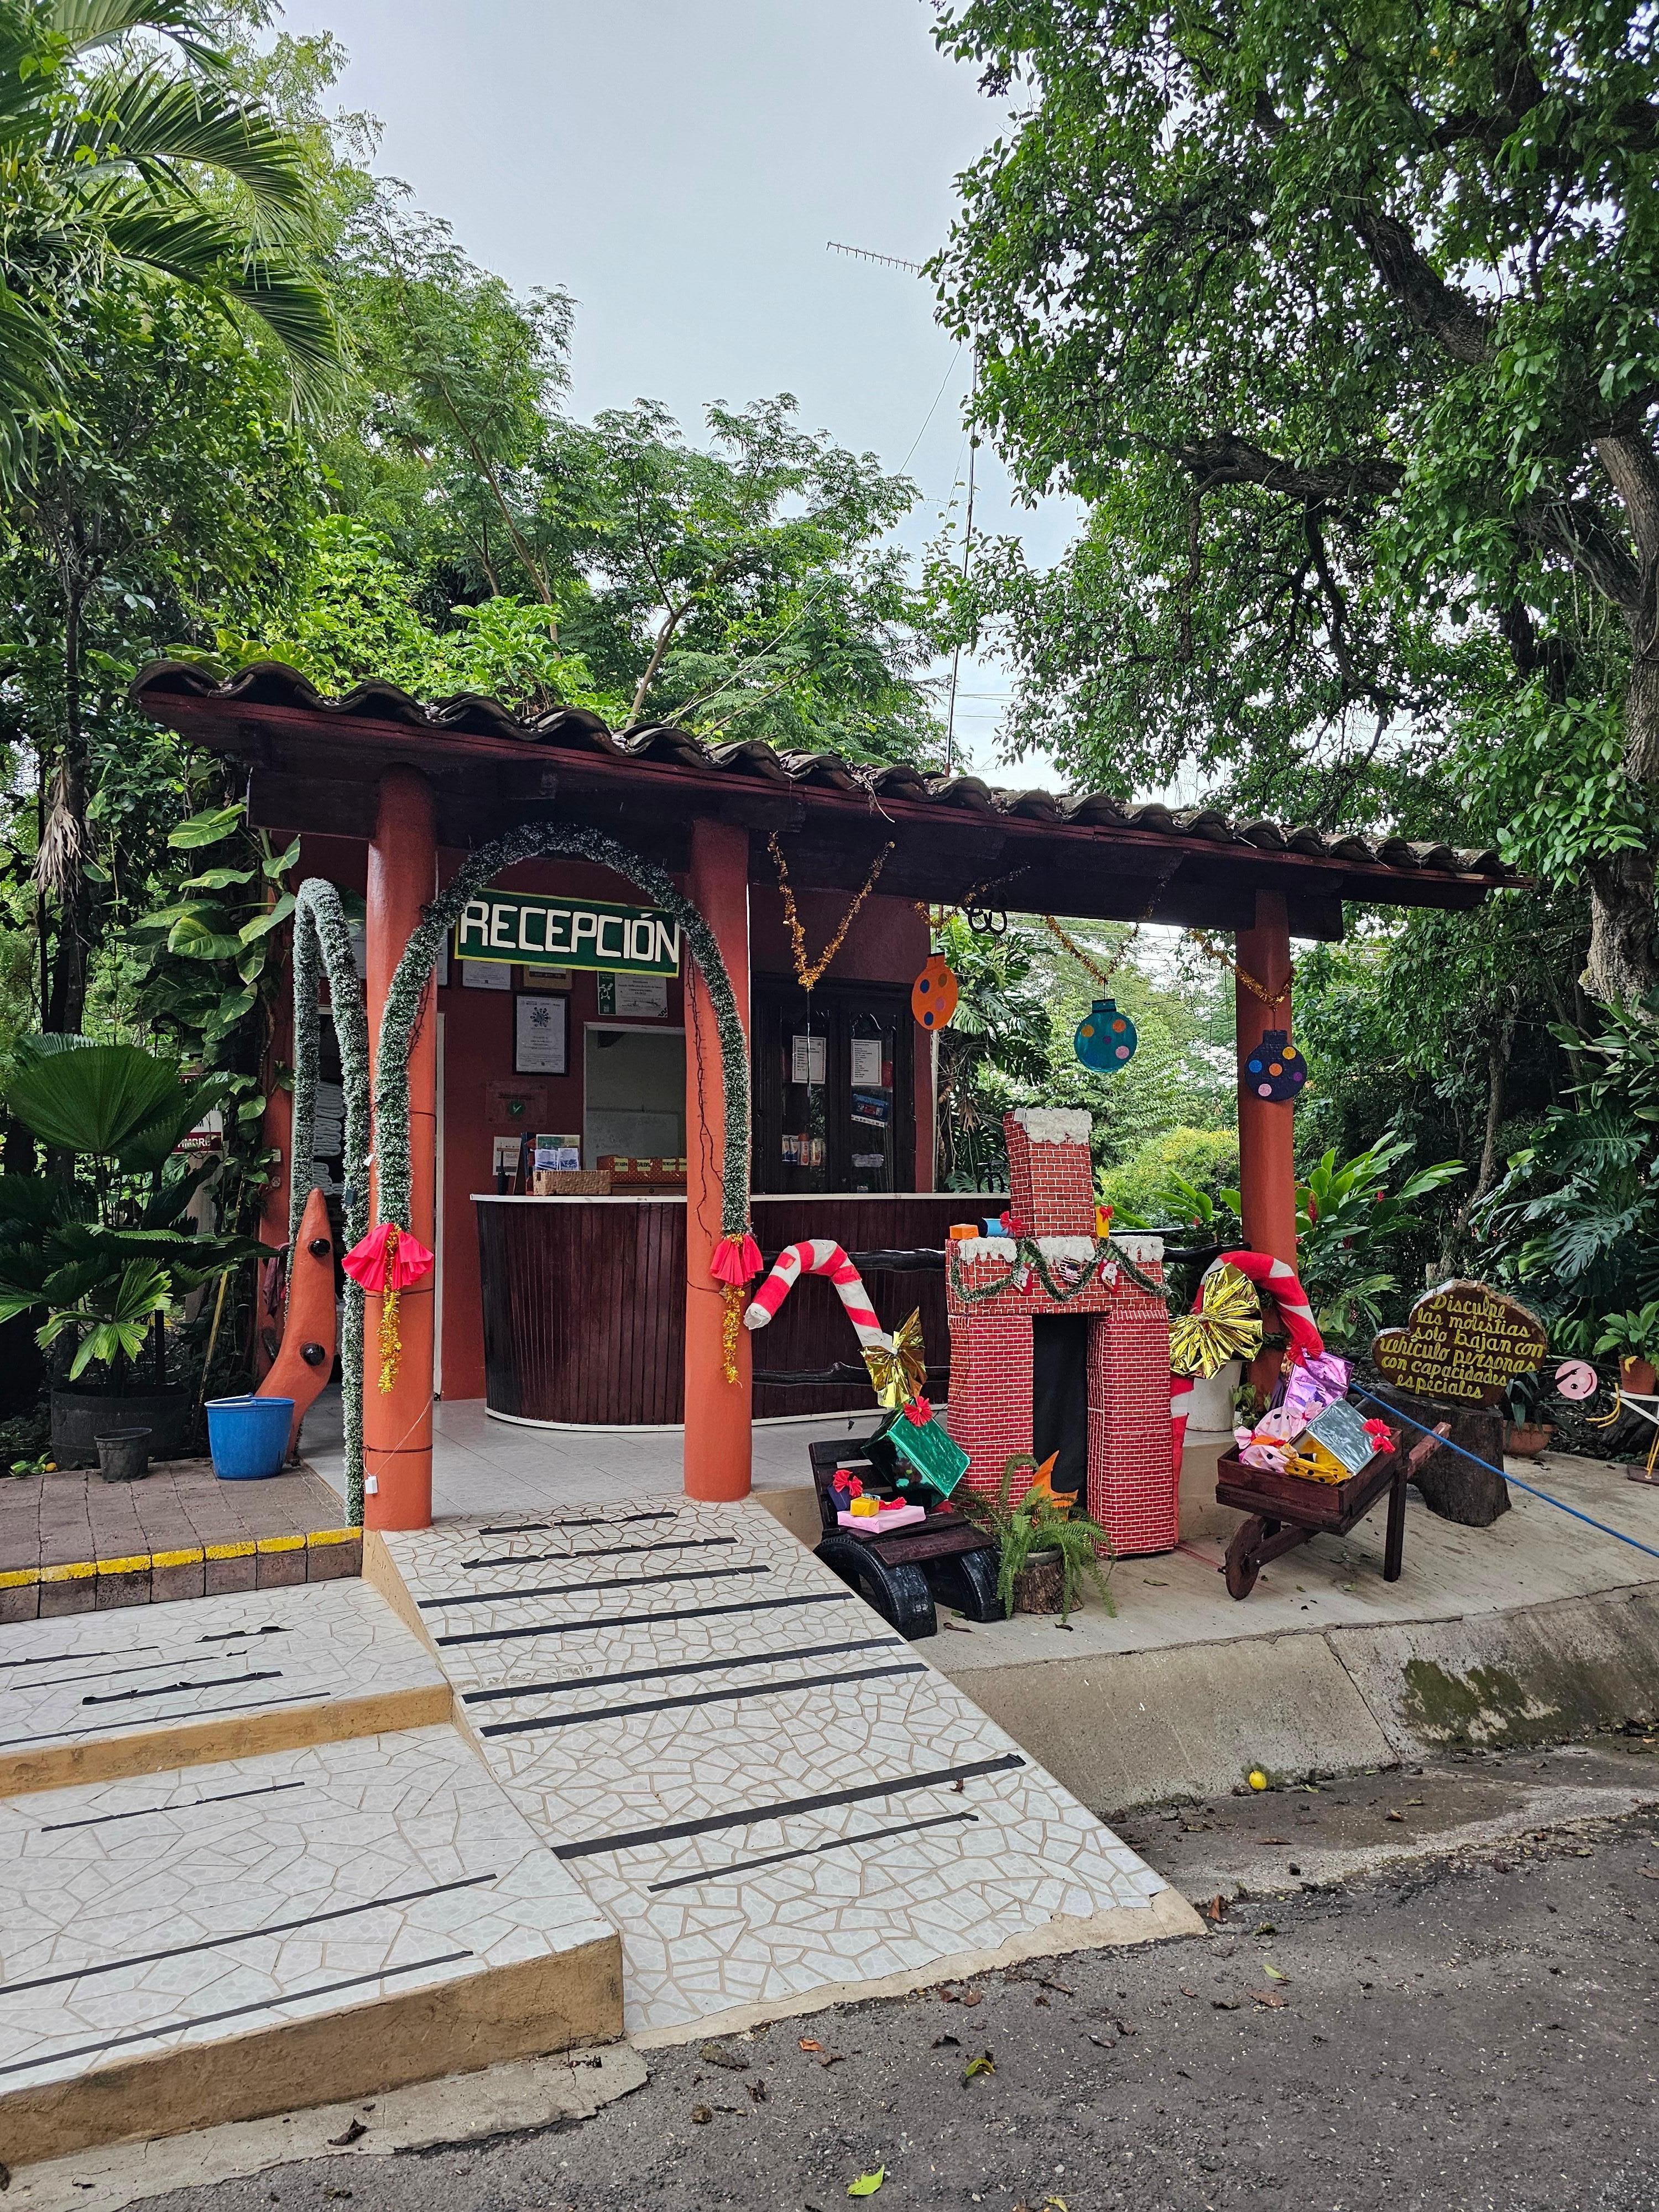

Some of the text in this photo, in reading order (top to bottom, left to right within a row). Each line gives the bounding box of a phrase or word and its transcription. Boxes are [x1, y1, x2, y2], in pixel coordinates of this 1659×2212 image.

[460, 901, 679, 963] RECEPCIÓN
[1416, 1307, 1531, 1338] las molestias
[1429, 1295, 1505, 1320] Disculpe
[1411, 1327, 1544, 1359] solo bajan con
[1381, 1356, 1507, 1386] con capacidades
[1453, 1350, 1536, 1373] personas
[1395, 1374, 1484, 1399] especiales
